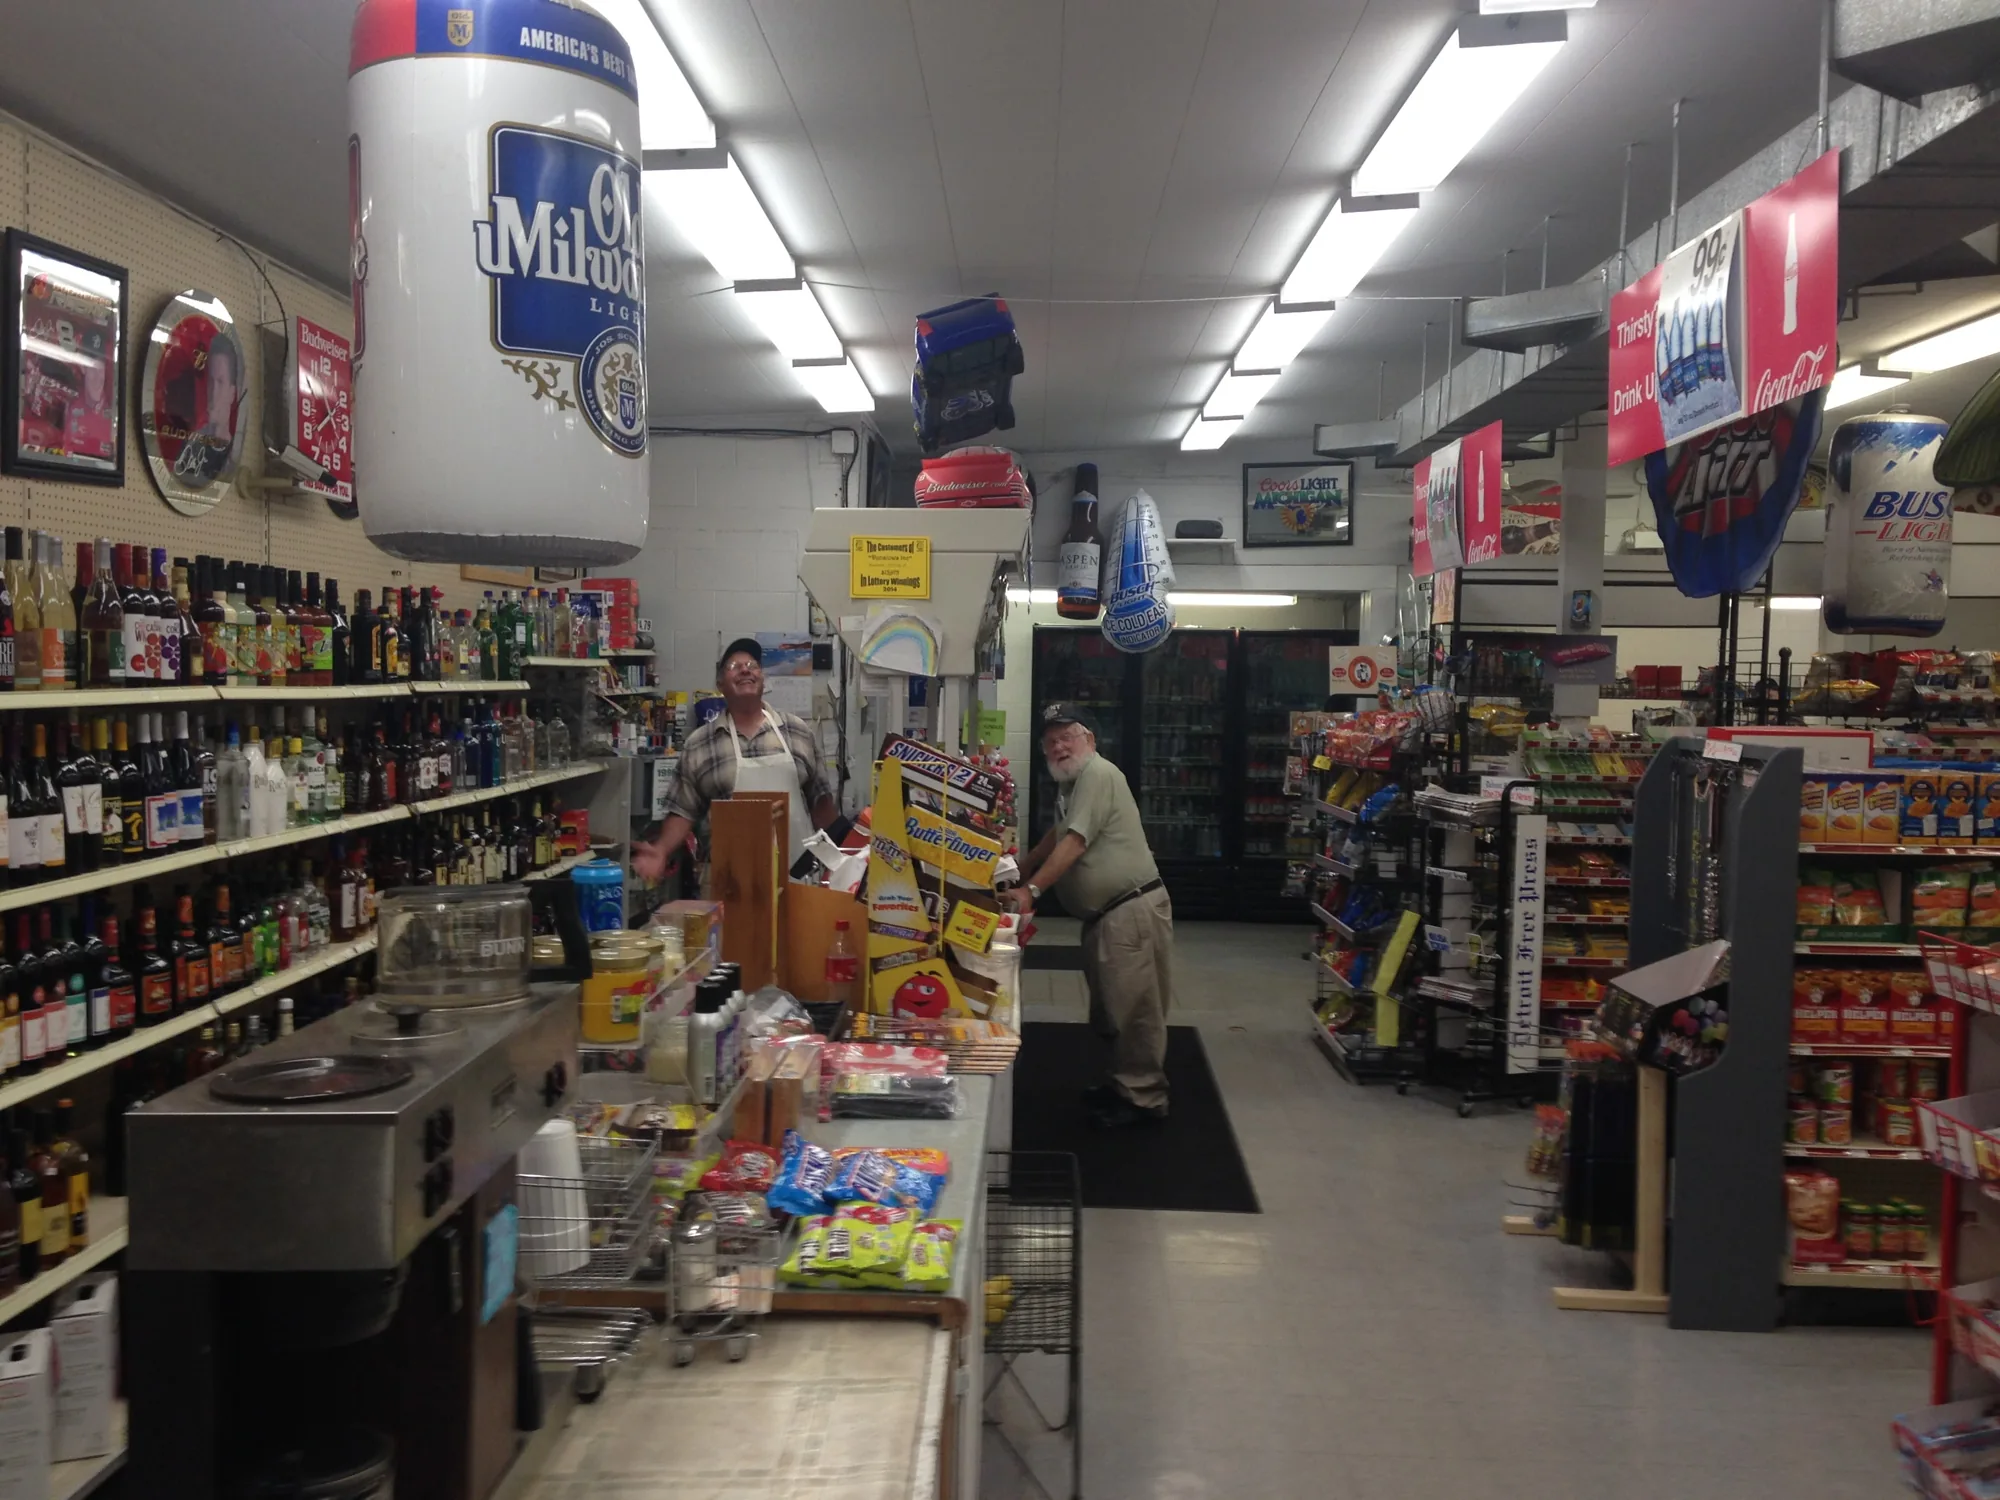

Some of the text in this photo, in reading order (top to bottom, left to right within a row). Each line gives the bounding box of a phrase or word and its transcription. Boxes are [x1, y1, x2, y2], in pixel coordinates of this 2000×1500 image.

[520, 27, 599, 64] AMERICA'S
[602, 50, 627, 78] BEST
[301, 323, 348, 362] Budweiser
[320, 356, 331, 377] 12
[339, 390, 347, 409] 2
[1614, 376, 1643, 416] Drink
[302, 398, 311, 416] 9
[304, 422, 313, 440] 8
[341, 415, 349, 432] 3
[311, 447, 320, 461] 7
[338, 438, 347, 453] 4
[332, 450, 341, 471] 5
[1260, 477, 1338, 491] Coors LIGHT
[1253, 490, 1342, 510] MICHIGAN
[866, 540, 915, 554] The Customers of
[860, 574, 921, 589] In Lottery Winnings
[1111, 580, 1155, 604] BUSCH
[1117, 614, 1146, 632] COLD
[1119, 625, 1160, 644] INDICATOR
[888, 741, 972, 780] SNICKERS 2
[904, 816, 998, 863] Butterfinger
[1517, 837, 1542, 903] Press
[871, 903, 920, 912] Favorites
[1514, 910, 1538, 963] Free
[480, 936, 525, 958] BUNN
